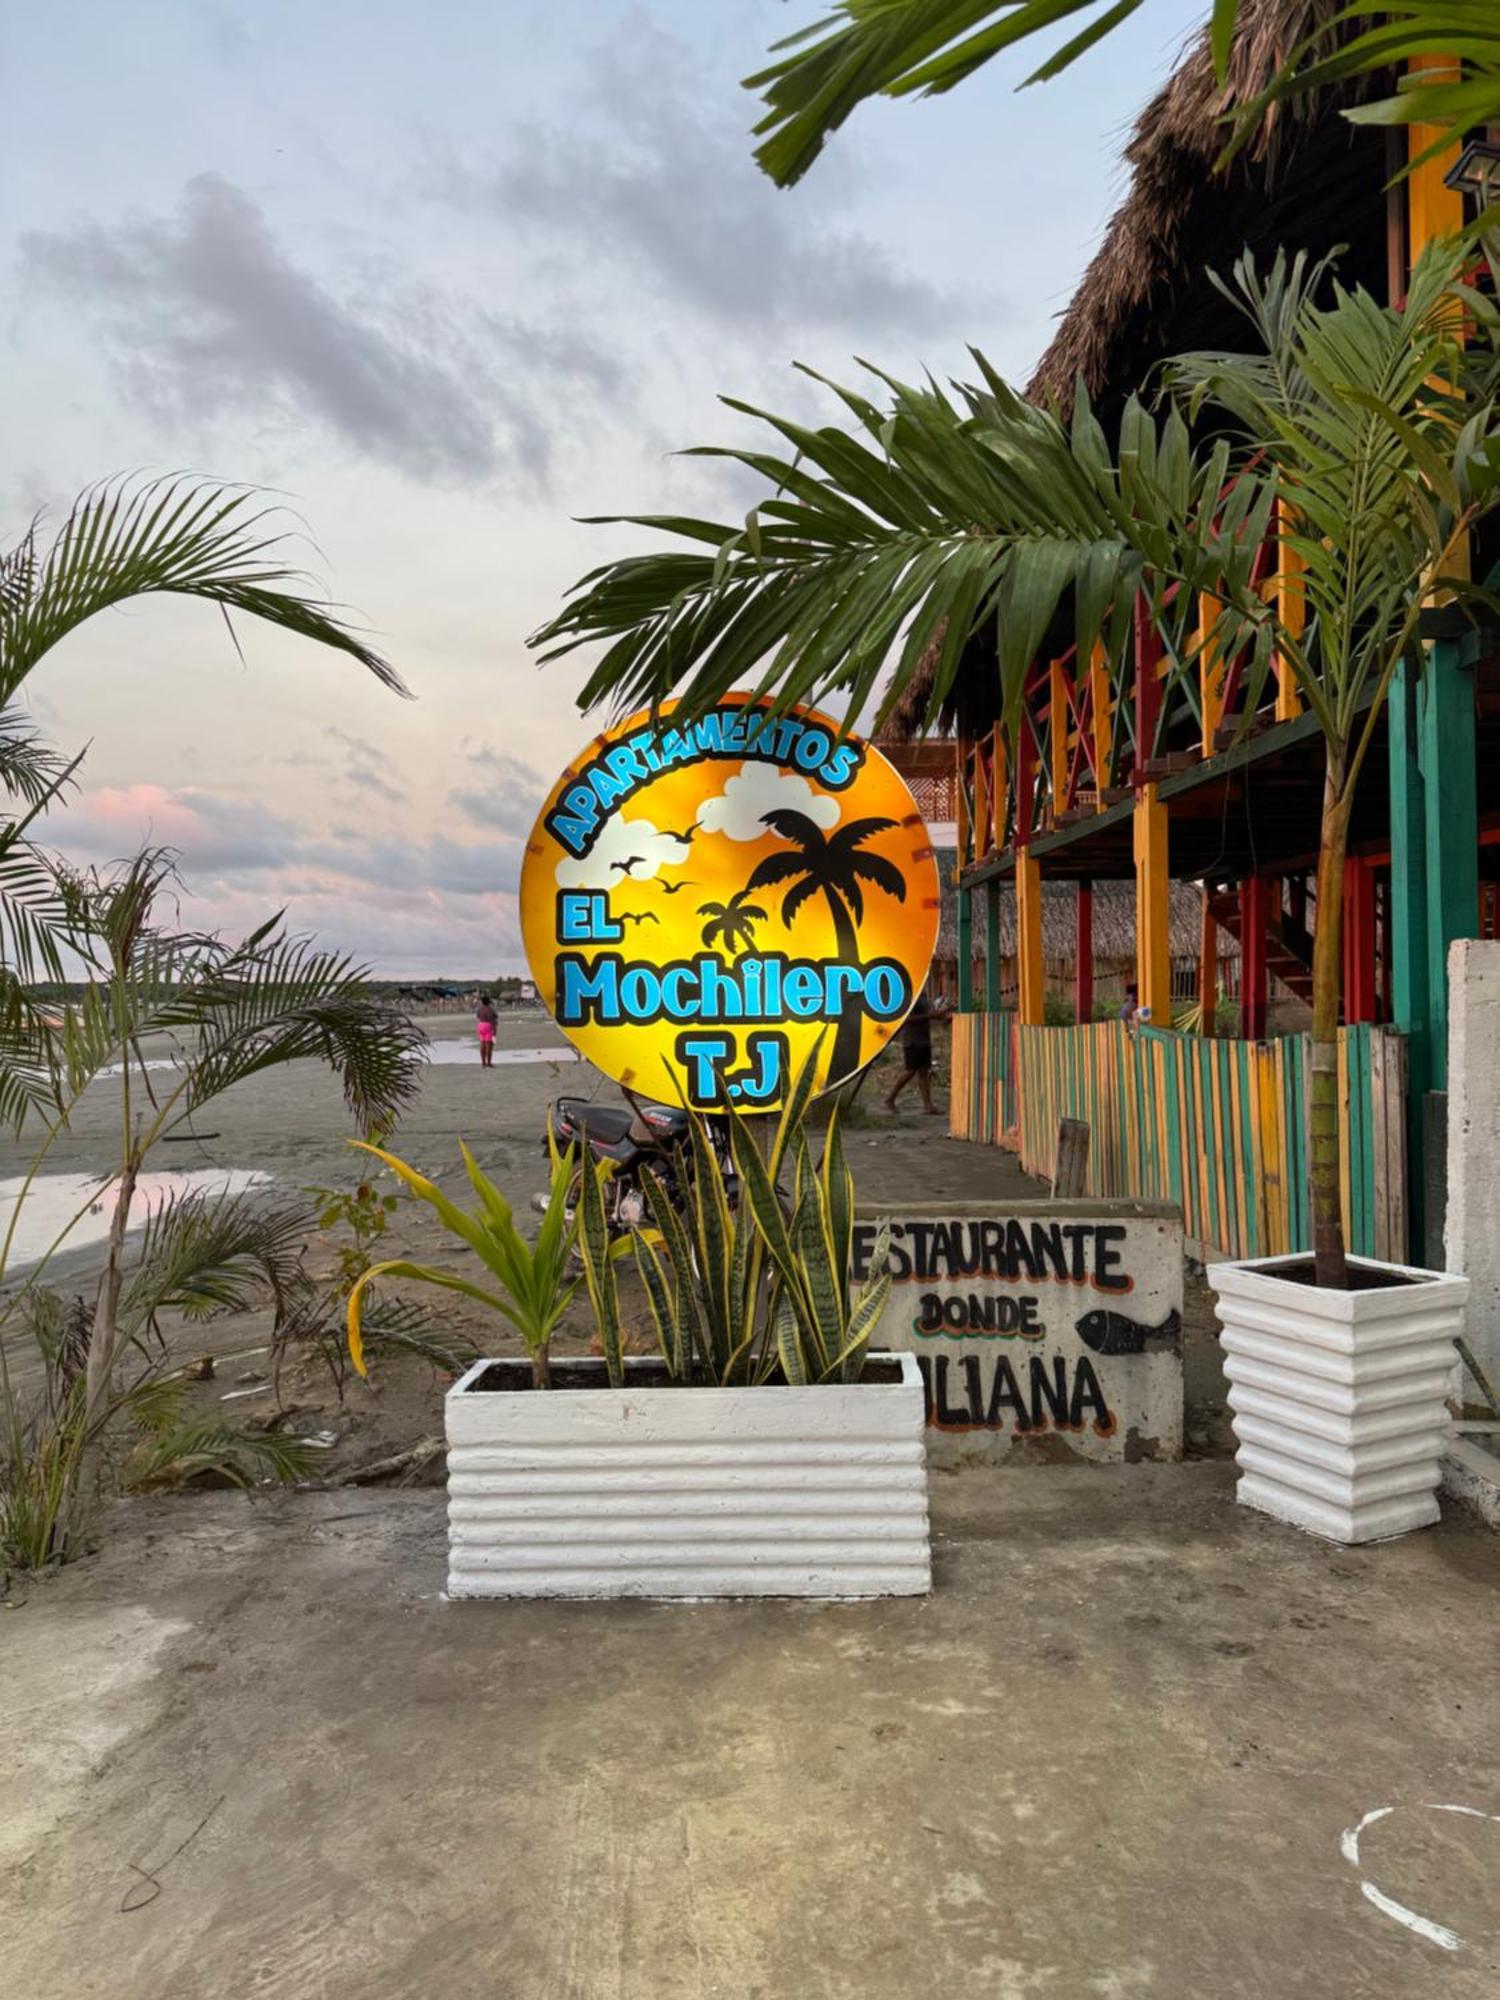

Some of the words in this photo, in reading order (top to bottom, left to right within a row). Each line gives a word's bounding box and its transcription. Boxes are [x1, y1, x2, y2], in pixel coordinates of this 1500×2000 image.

[549, 709, 861, 854] APARTAMENTOS
[560, 892, 622, 942] EL
[560, 955, 907, 1022] Mochilero
[681, 1036, 783, 1103] T.J
[850, 1219, 1128, 1289] ESTAURANTE
[918, 1293, 1041, 1335] DONDE
